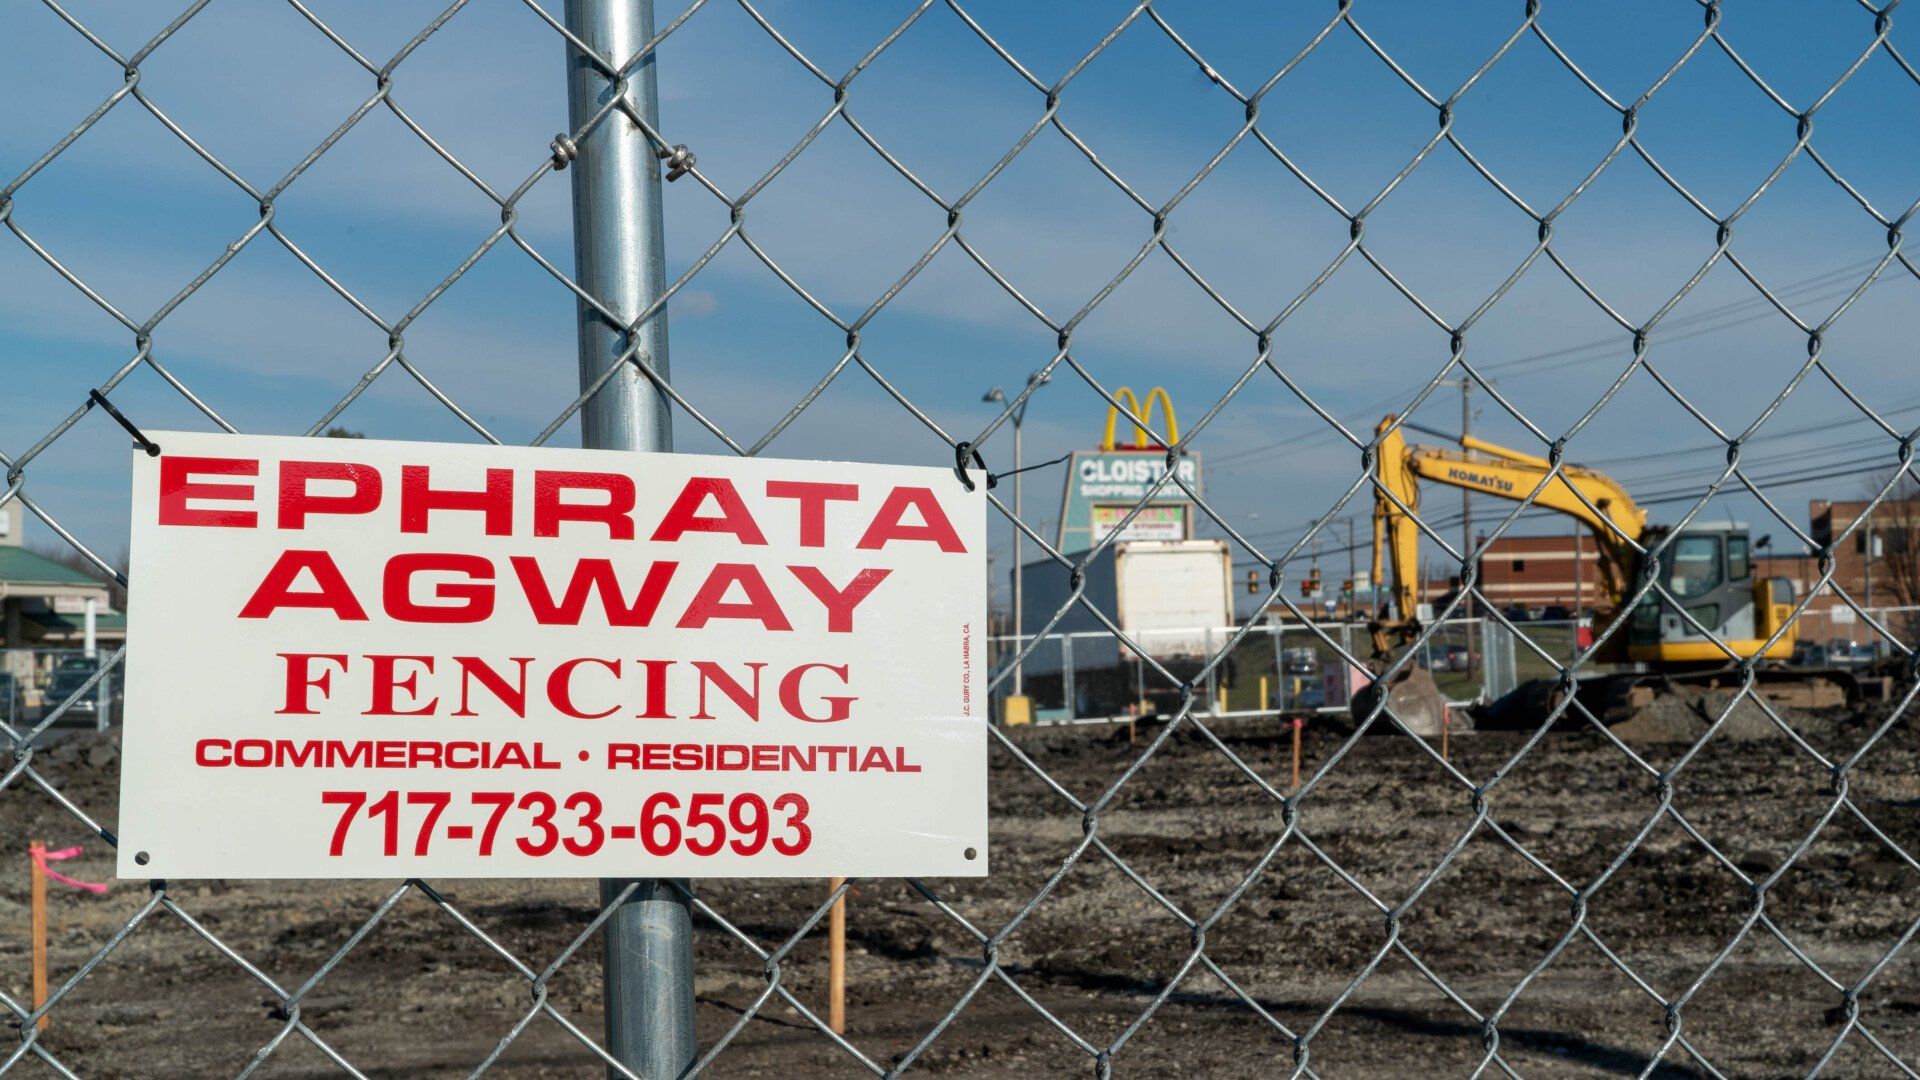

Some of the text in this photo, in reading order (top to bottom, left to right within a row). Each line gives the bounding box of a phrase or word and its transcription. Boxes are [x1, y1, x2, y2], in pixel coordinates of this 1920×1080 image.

[1080, 458, 1195, 482] CLOISTR
[1448, 467, 1513, 491] KOMATSU
[157, 455, 967, 554] EPHRATA
[1081, 484, 1144, 497] SHOPPING
[238, 549, 892, 633] AGWAY
[963, 660, 970, 669] LA
[275, 652, 859, 723] FENCING
[195, 738, 921, 773] COMMERCIAL RESIDENTIAL
[321, 790, 813, 858] 717-733-6593
